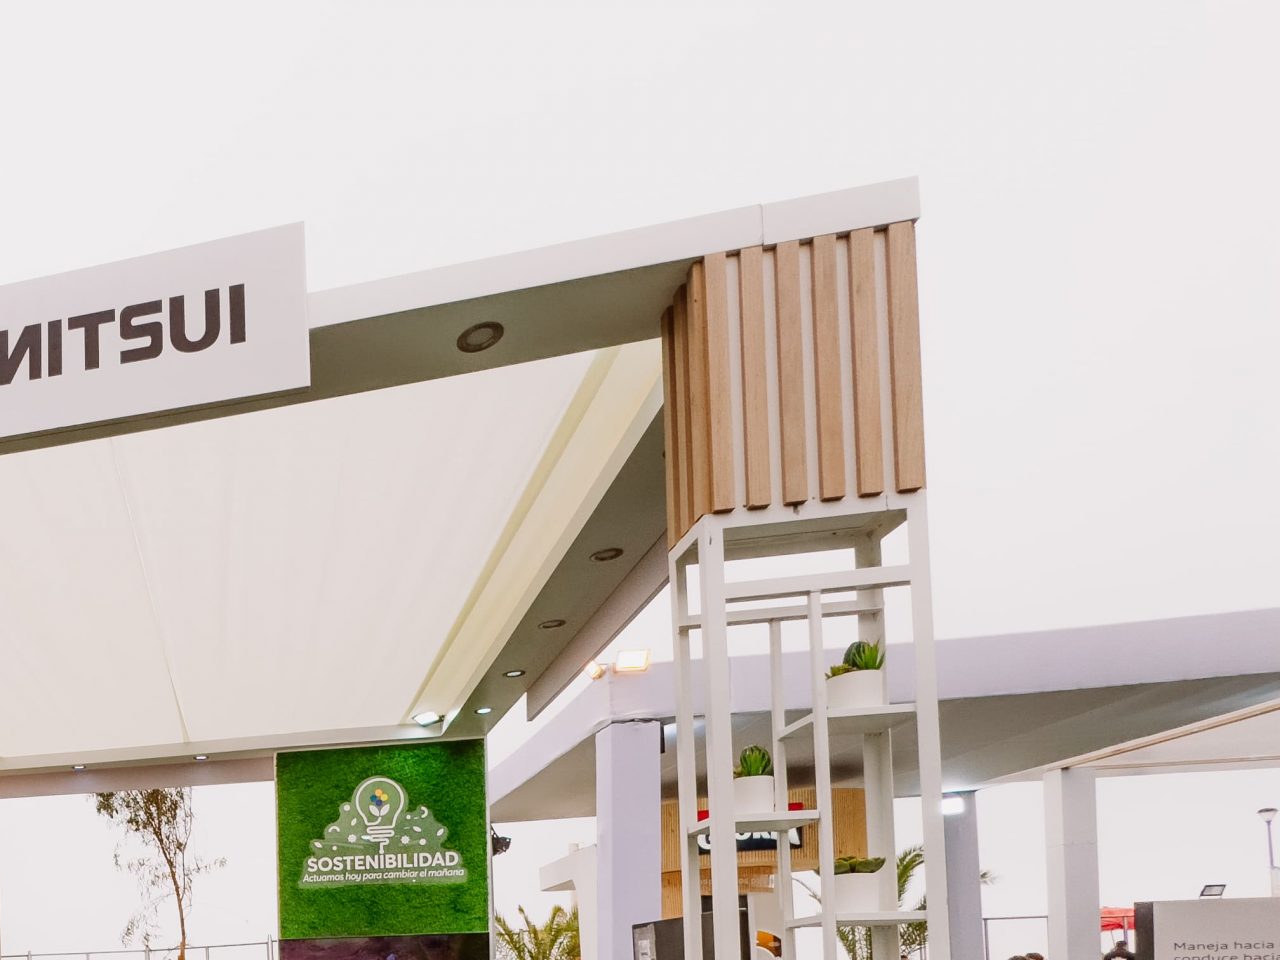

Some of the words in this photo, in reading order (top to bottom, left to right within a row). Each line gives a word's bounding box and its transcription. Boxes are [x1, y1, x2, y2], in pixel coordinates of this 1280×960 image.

[307, 851, 459, 872] SOSTENIBILIDAD
[303, 873, 344, 882] Actuamos
[345, 872, 361, 882] hoy
[362, 872, 382, 880] para
[383, 869, 418, 879] cambiar
[420, 868, 427, 877] el
[428, 868, 464, 877] mañana
[1173, 942, 1228, 952] Maneja
[1234, 941, 1274, 950] hacia
